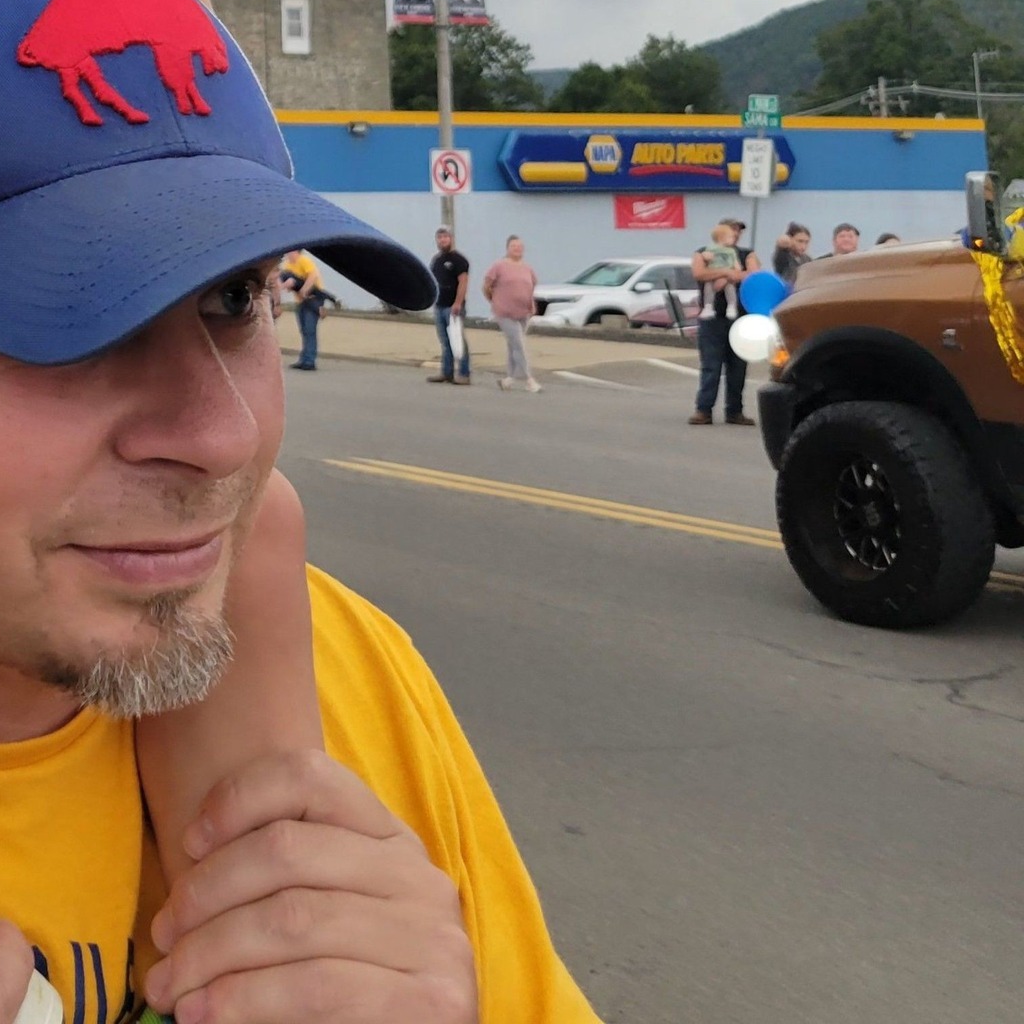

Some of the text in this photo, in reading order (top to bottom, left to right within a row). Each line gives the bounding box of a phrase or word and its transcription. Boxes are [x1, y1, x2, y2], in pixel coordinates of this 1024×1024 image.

[591, 142, 725, 165] NAPA AUTO PARTS
